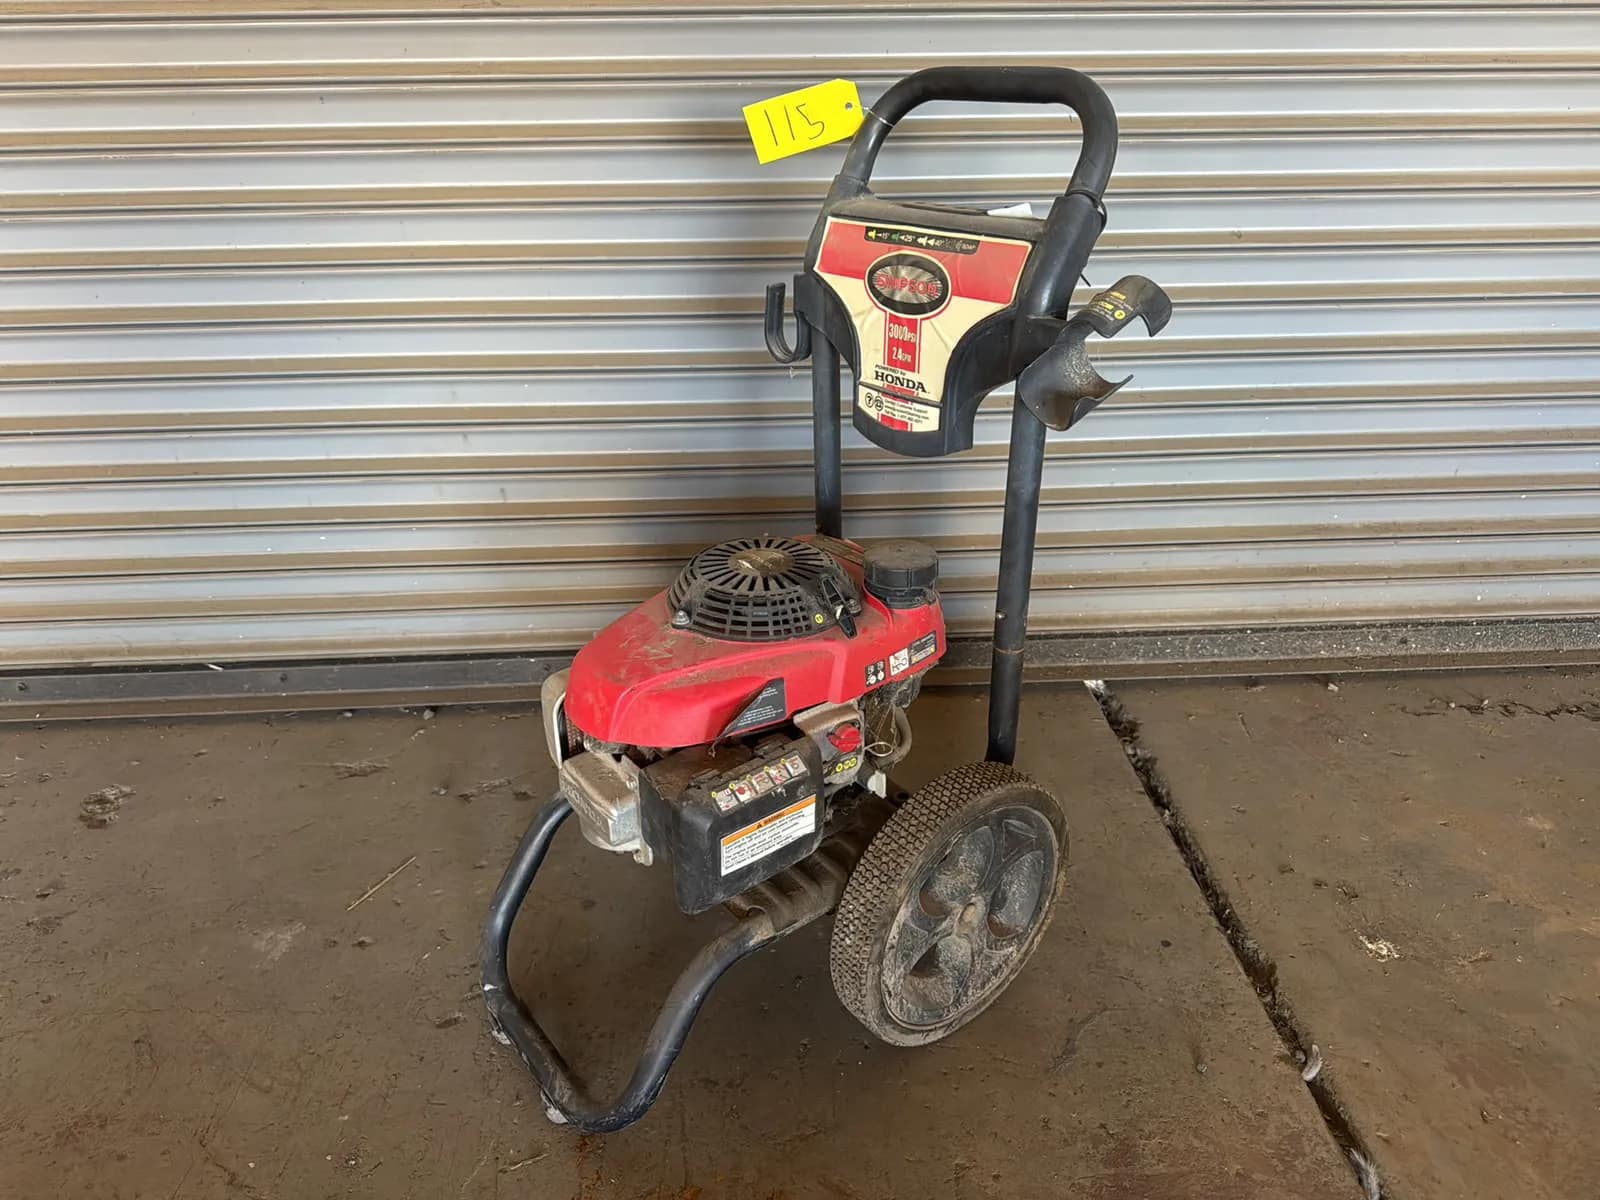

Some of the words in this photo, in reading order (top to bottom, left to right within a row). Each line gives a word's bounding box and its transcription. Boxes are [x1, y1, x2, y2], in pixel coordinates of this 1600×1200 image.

[764, 103, 825, 148] 115
[876, 273, 938, 296] SIMPSON
[875, 364, 899, 374] POWERED
[874, 371, 927, 393] HONDA
